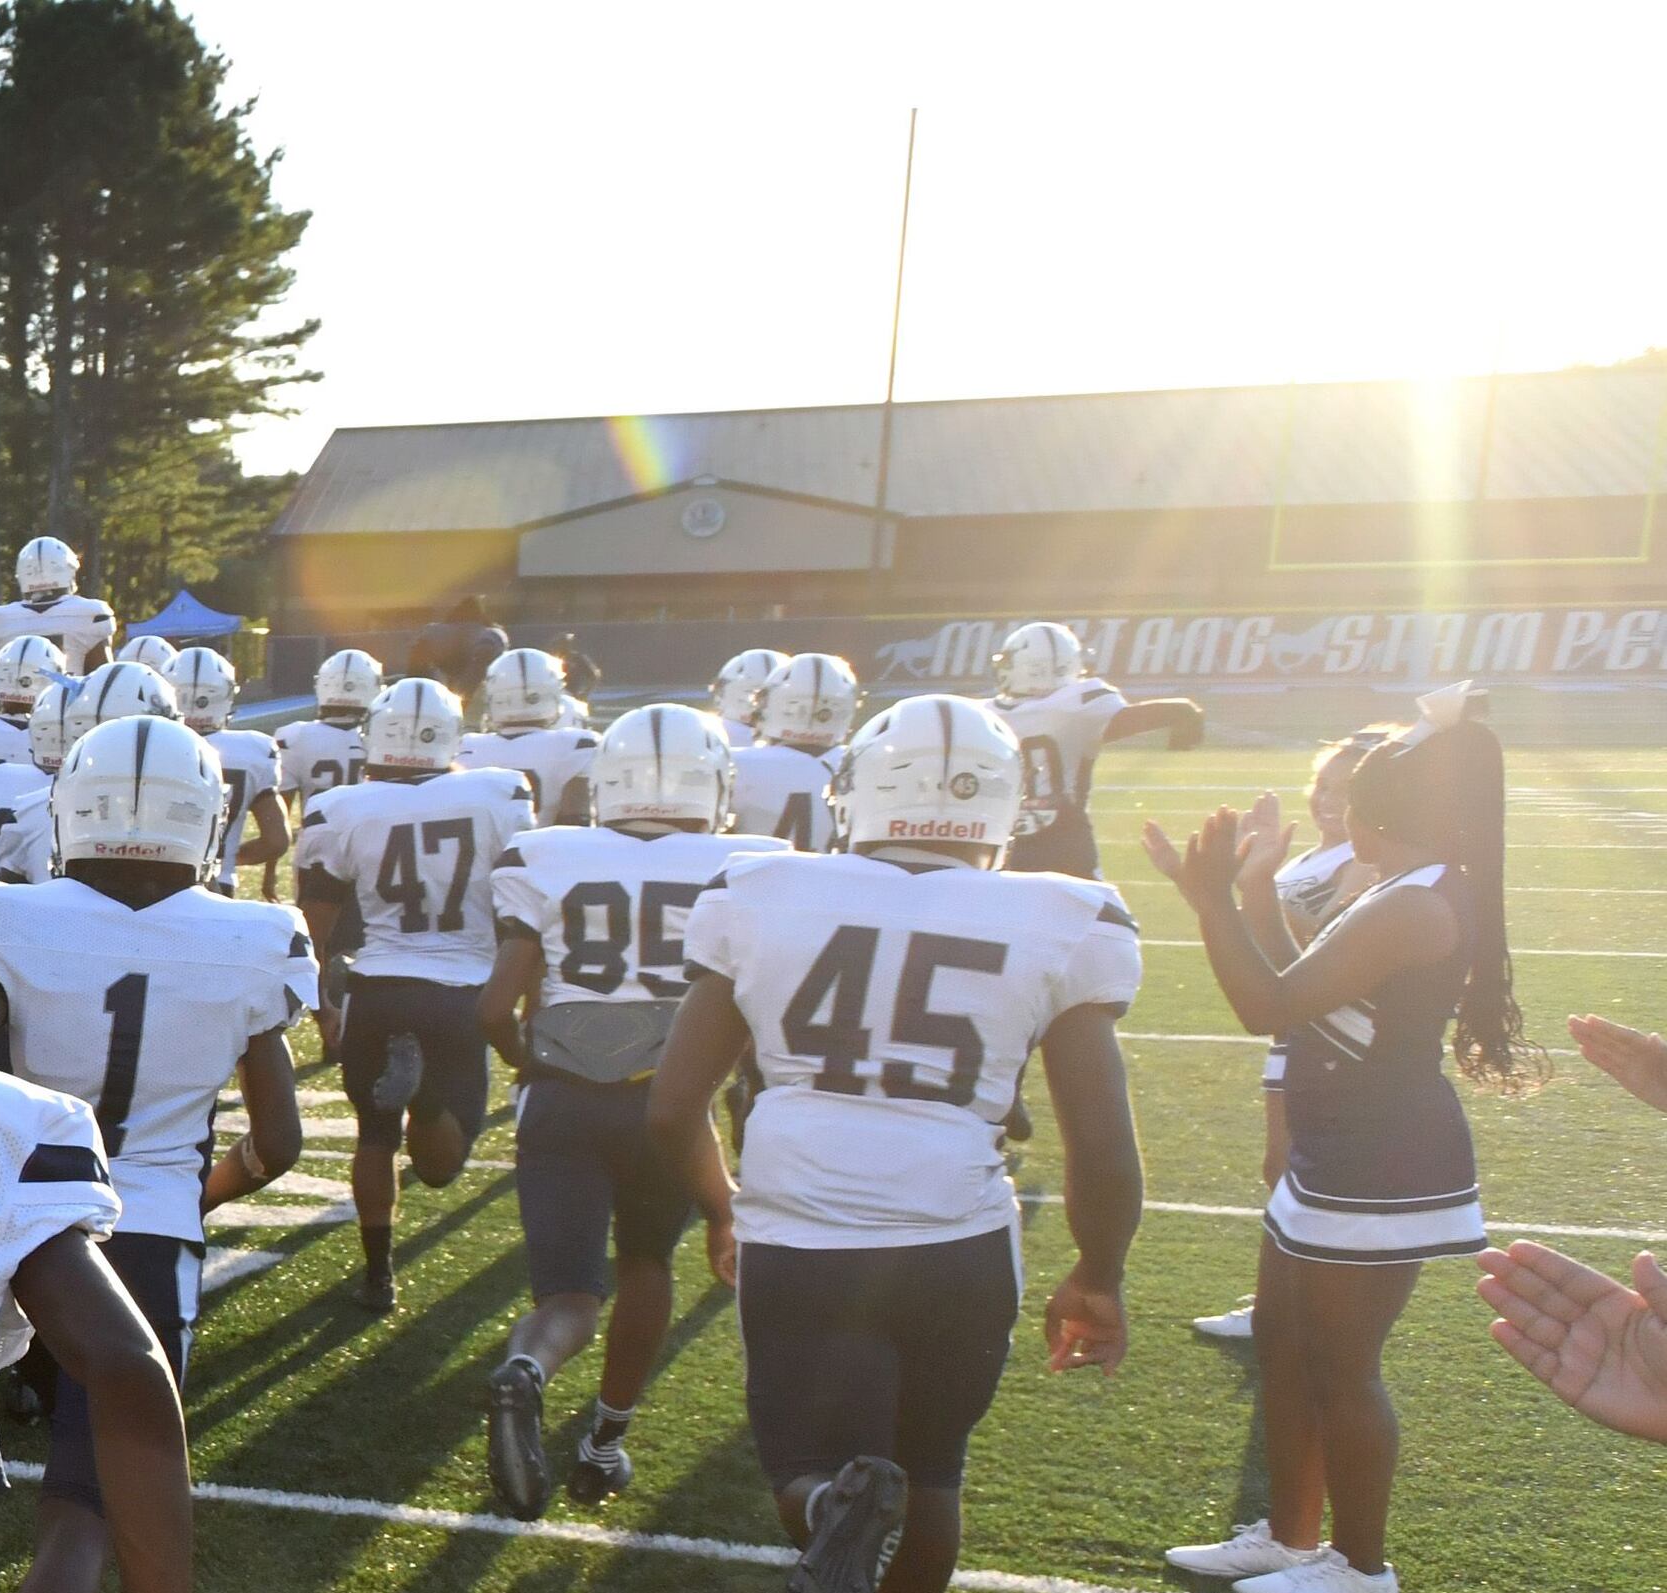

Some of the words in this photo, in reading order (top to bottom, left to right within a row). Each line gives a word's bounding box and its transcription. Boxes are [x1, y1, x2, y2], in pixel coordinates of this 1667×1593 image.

[929, 616, 1275, 677] MTANG
[384, 754, 435, 767] Riddell
[375, 817, 475, 934] 47
[889, 819, 986, 839] Riddell
[560, 880, 707, 998] 85
[103, 973, 150, 1159] 1
[782, 924, 1010, 1107] 45
